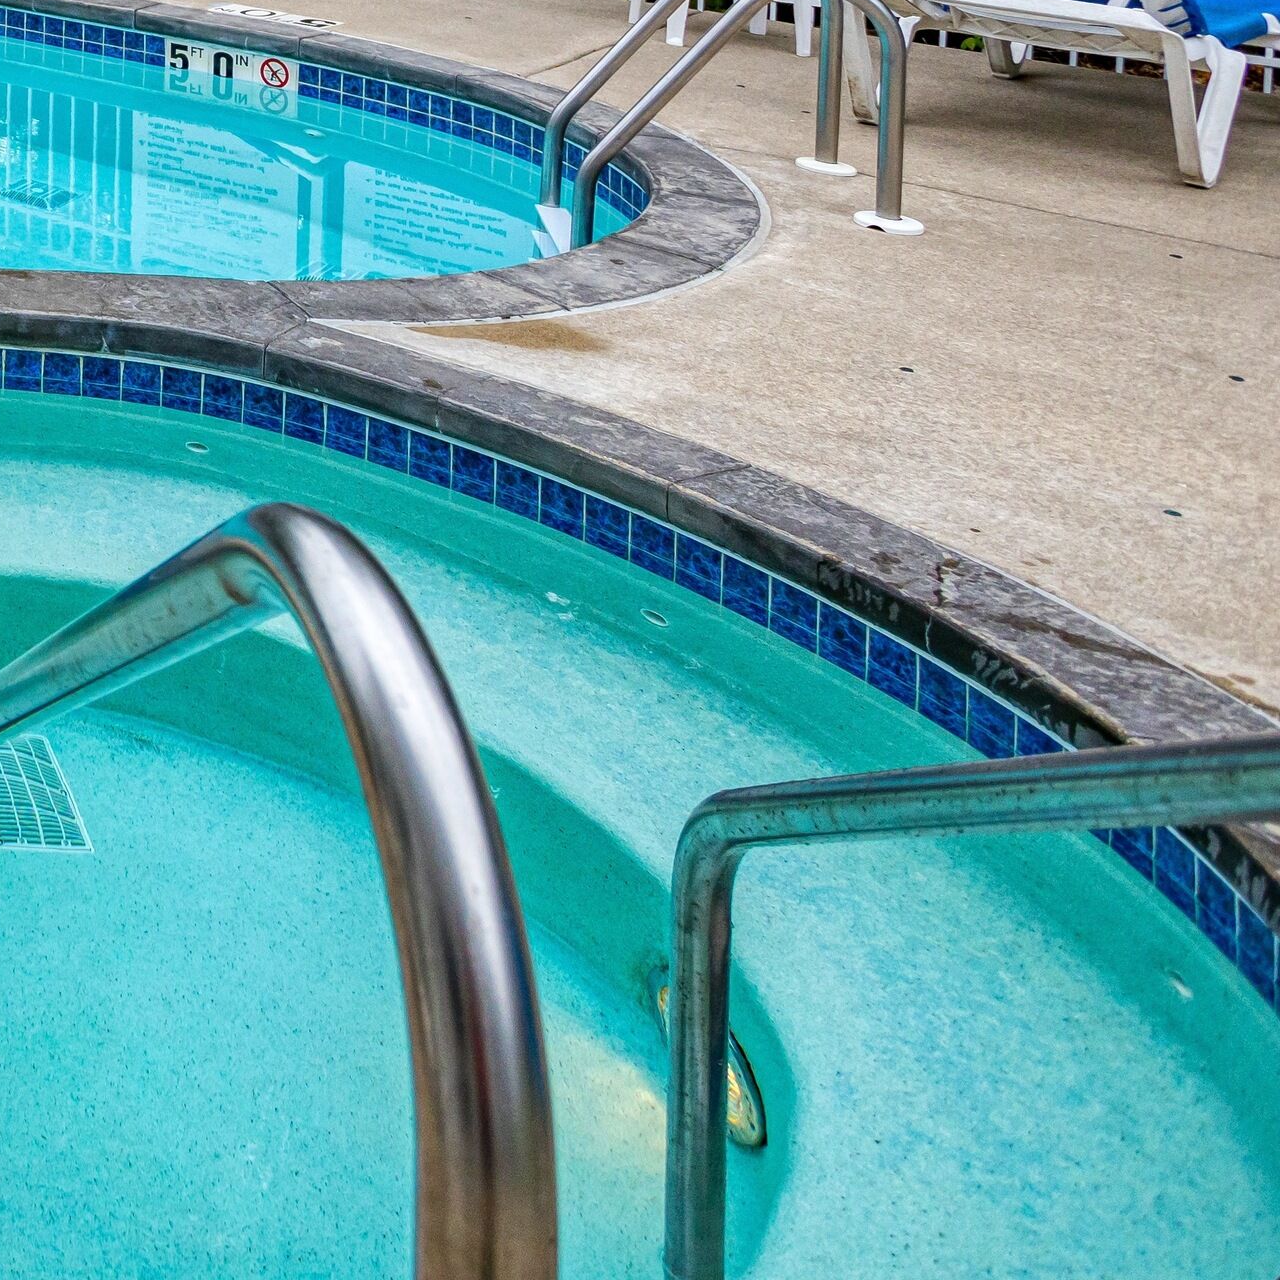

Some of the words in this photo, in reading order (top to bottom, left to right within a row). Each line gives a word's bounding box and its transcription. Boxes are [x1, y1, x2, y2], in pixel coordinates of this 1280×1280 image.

[169, 42, 189, 70] 5
[190, 47, 204, 58] FT
[213, 51, 233, 78] 0
[235, 54, 249, 67] IN
